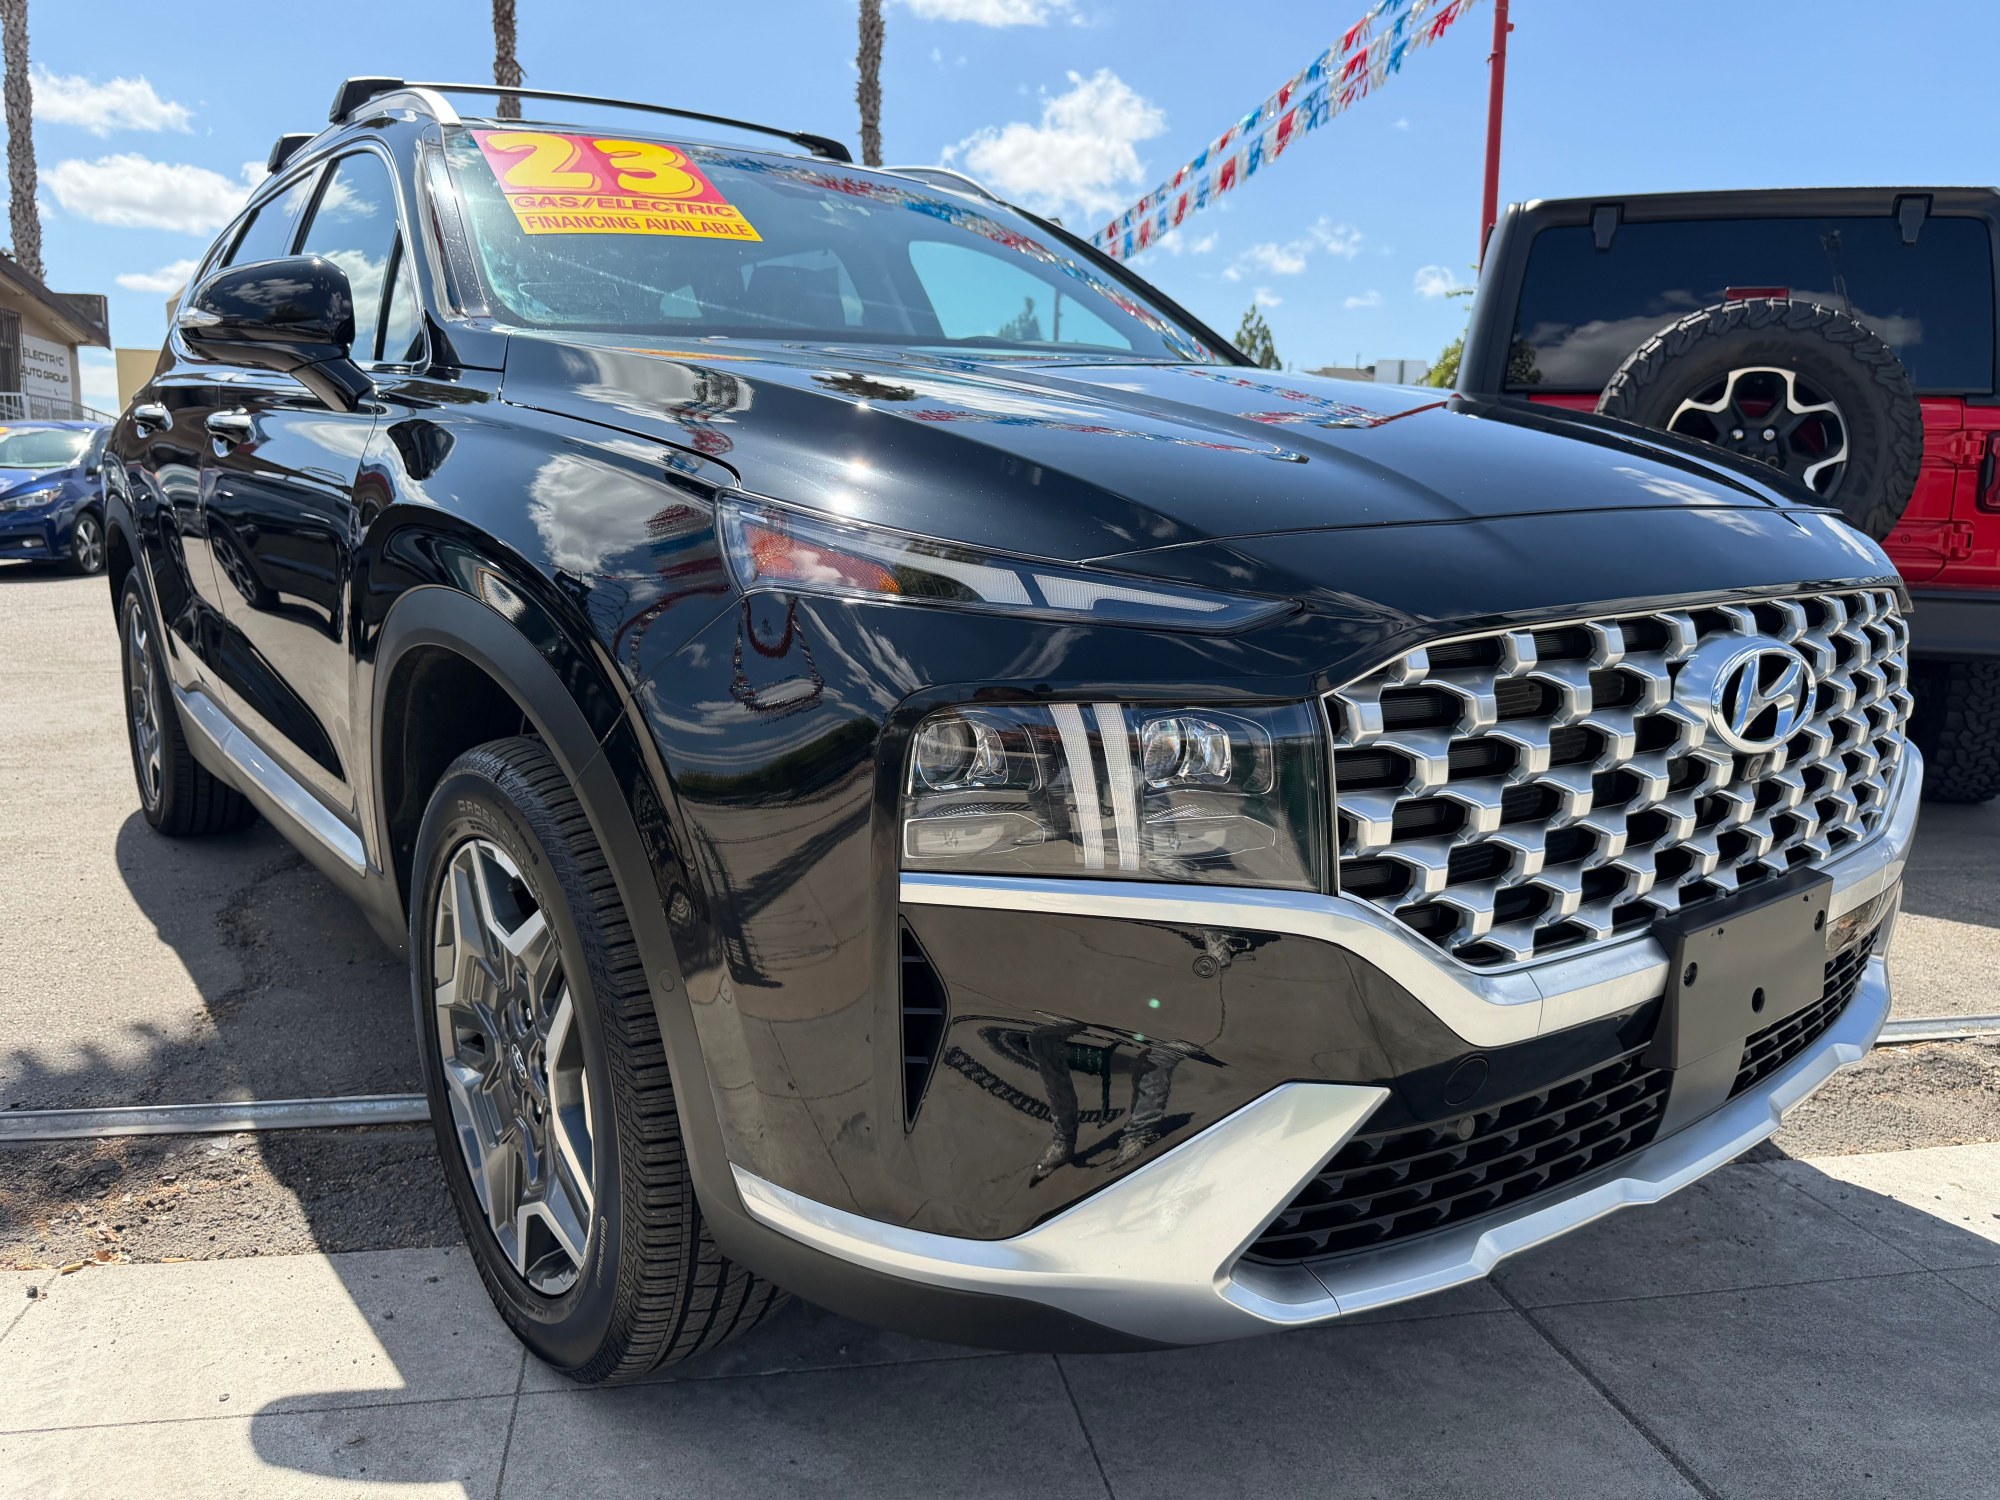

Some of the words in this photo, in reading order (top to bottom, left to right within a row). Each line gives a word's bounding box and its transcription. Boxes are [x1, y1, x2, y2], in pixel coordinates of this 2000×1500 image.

[484, 132, 704, 199] 23
[513, 195, 737, 218] GAS/ELECTRIC
[524, 215, 641, 230] FINANCING
[645, 217, 753, 237] AVAILABLE
[23, 347, 64, 367] ELECTRIC
